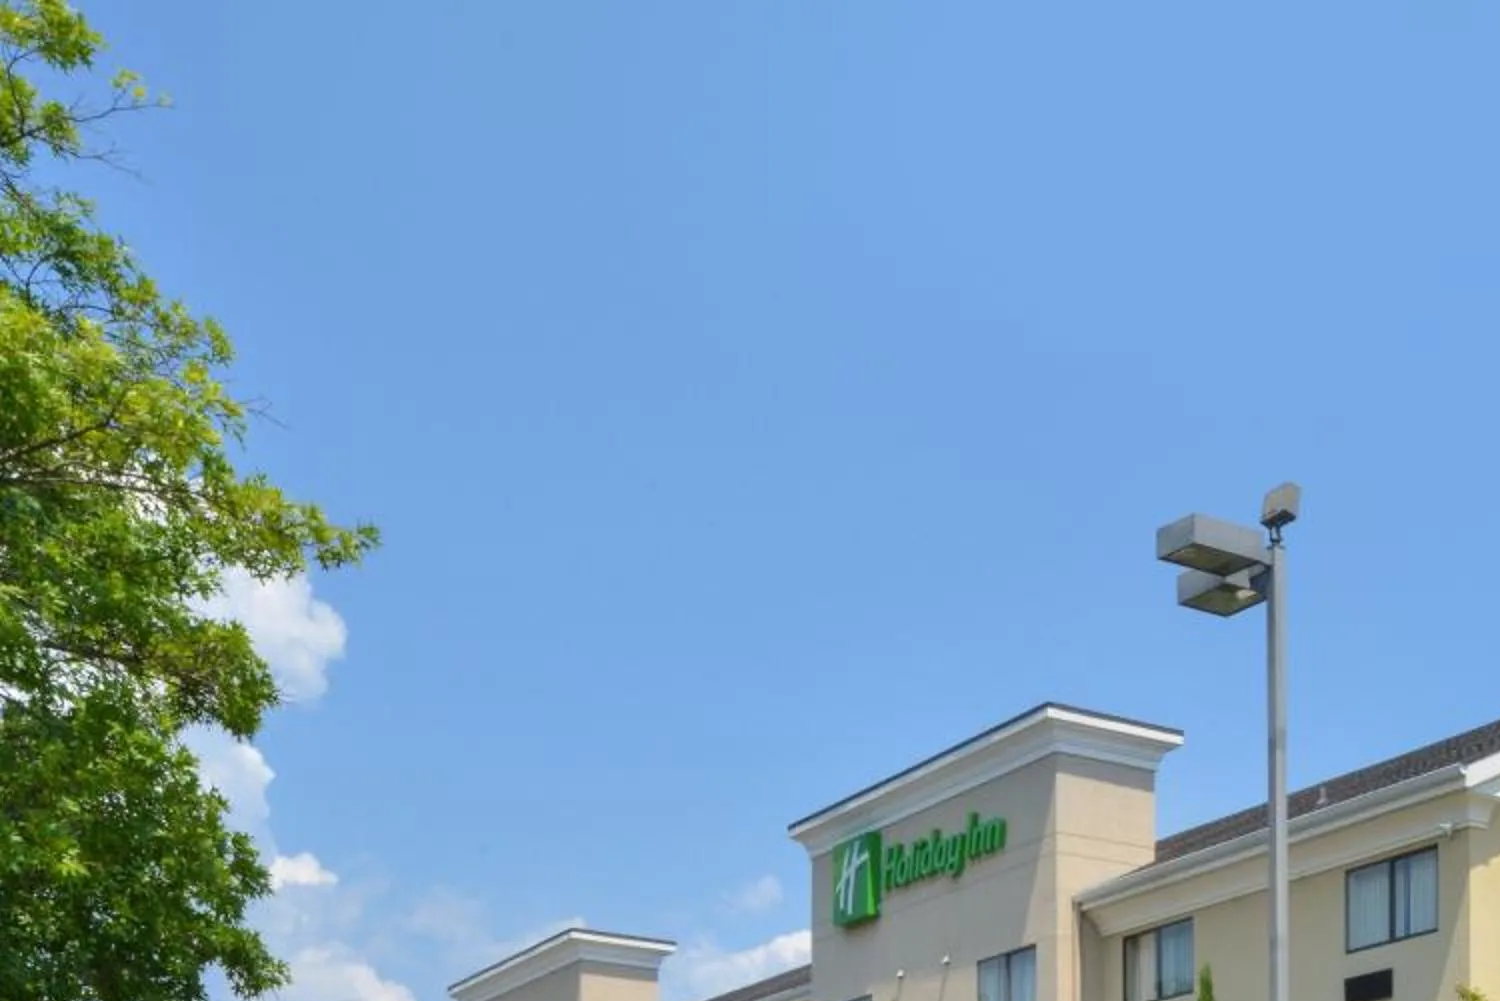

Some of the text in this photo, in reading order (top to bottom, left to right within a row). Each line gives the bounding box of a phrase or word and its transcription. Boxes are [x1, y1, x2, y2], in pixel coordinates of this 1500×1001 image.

[836, 841, 869, 915] H
[882, 811, 1007, 891] Holiday Inn
